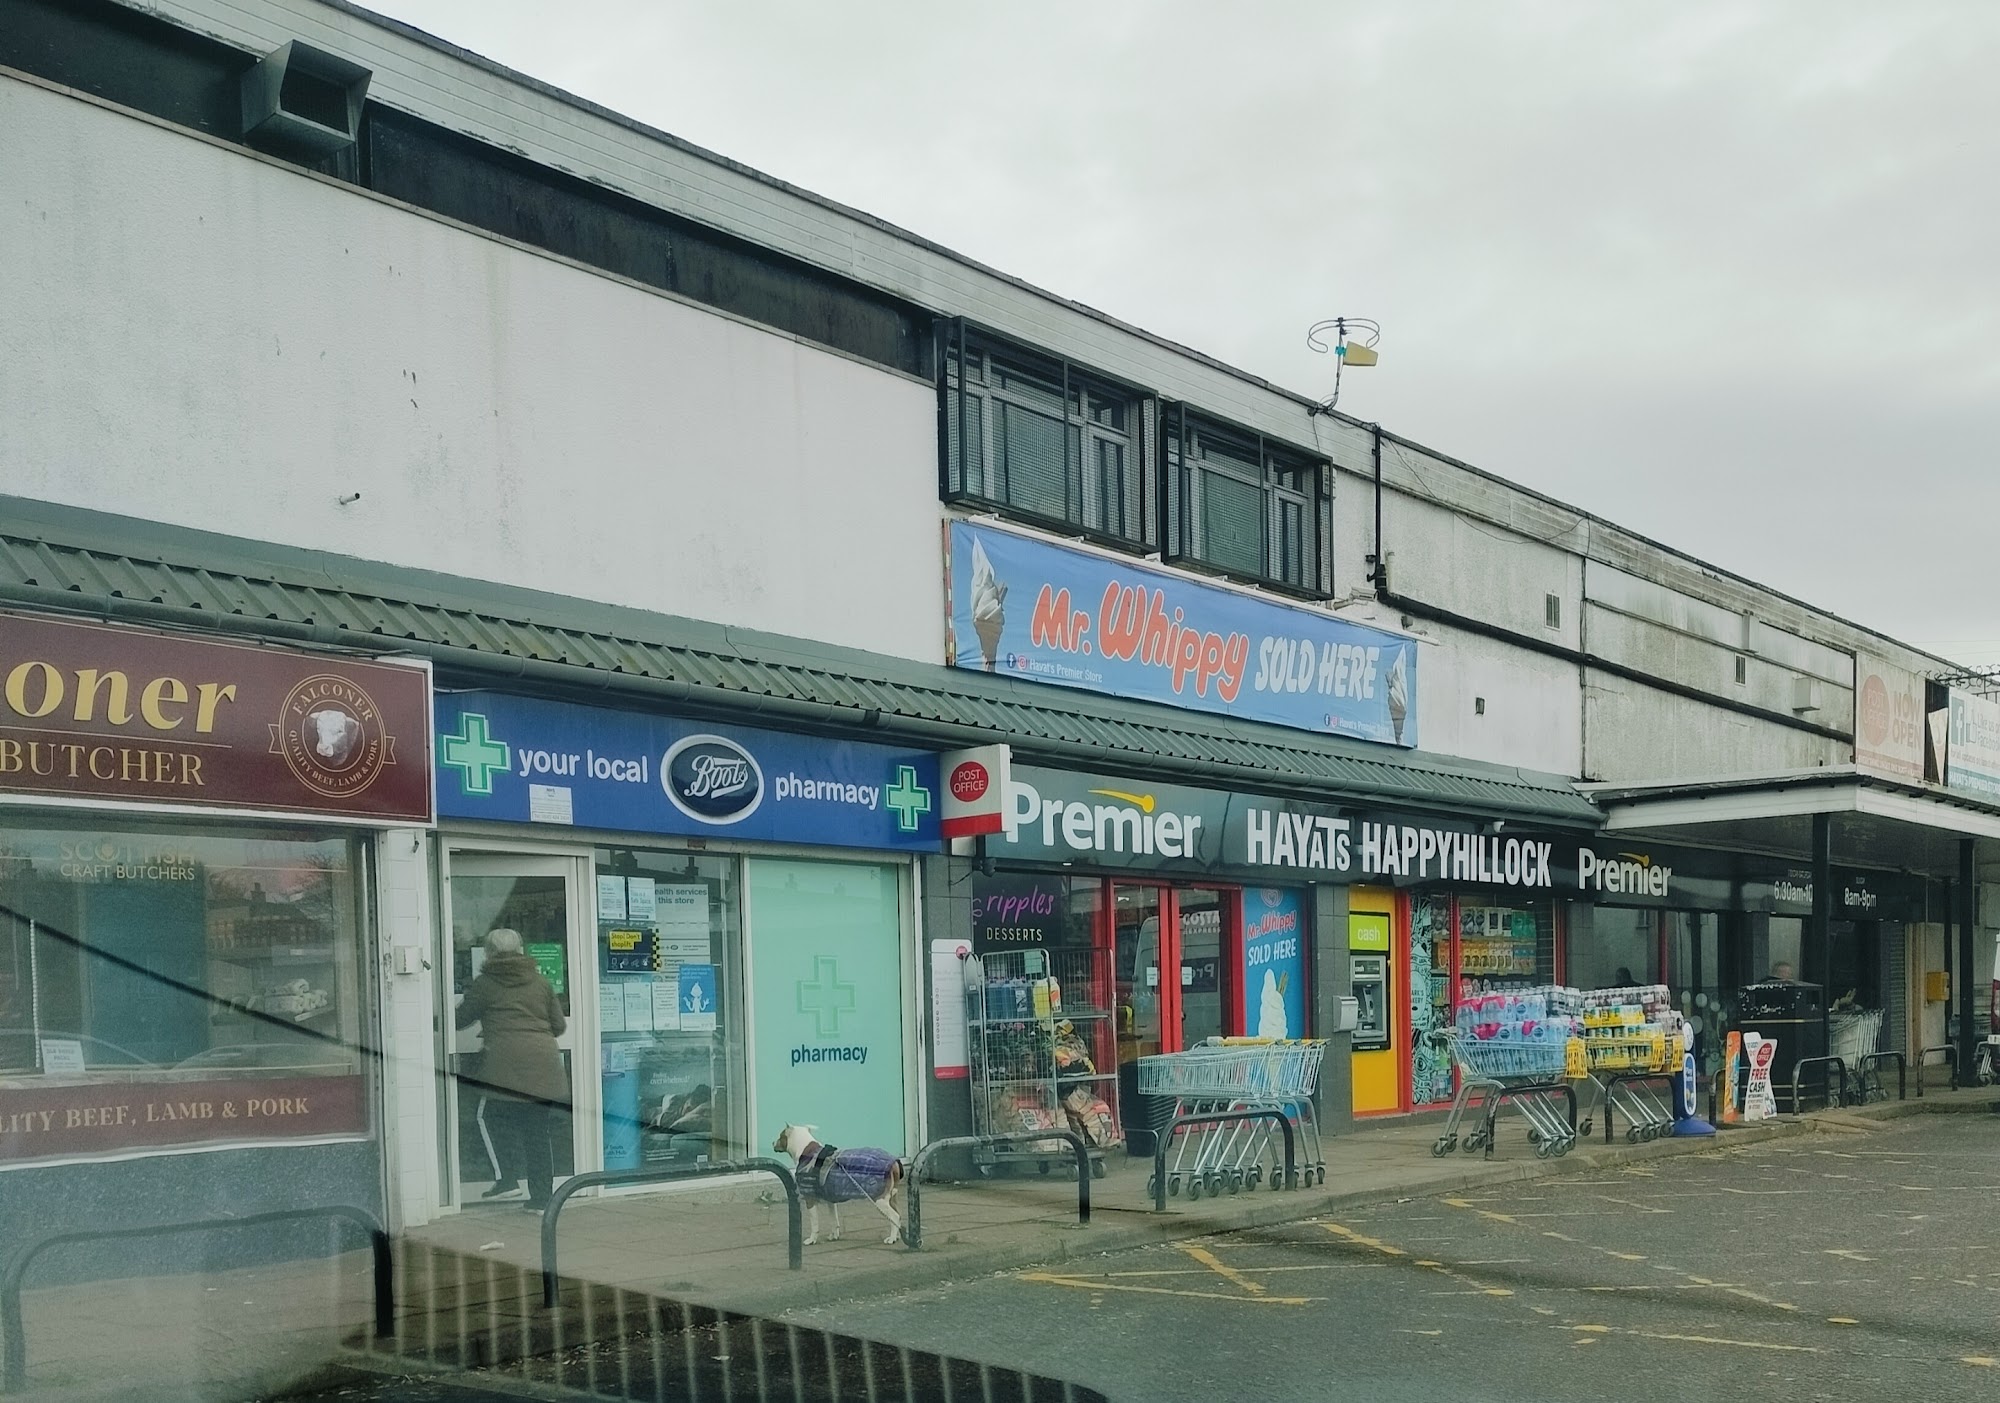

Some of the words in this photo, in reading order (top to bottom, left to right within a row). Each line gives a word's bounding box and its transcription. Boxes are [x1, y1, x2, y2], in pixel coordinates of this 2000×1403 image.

[1031, 583, 1092, 655] Mr.
[1099, 580, 1250, 703] Whippy
[1057, 664, 1083, 679] Premier
[1085, 669, 1103, 683] Store
[1255, 636, 1315, 694] SOLD
[1318, 641, 1381, 702] HERE
[5, 661, 237, 733] oner
[292, 683, 373, 721] FALCONER
[1894, 690, 1921, 723] NOW
[1892, 717, 1921, 750] OPEN
[0, 739, 205, 786] BUTCHER
[289, 730, 313, 772] QUALITY
[312, 770, 336, 787] BEEF,
[338, 772, 363, 787] LAMB
[362, 766, 369, 775] &
[366, 739, 378, 767] PORK
[518, 748, 580, 778] your
[587, 749, 649, 784] local
[958, 769, 981, 781] POST
[683, 754, 749, 799] Boots
[775, 772, 880, 811] pharmacy
[953, 780, 984, 793] OFFICE
[1006, 780, 1201, 858] Premier
[60, 841, 196, 865] SCOTTISH
[1362, 821, 1552, 888] HAPPYHILLOCK
[60, 863, 111, 878] CRAFT
[116, 865, 195, 881] BUTCHERS
[1579, 847, 1673, 897] Premier
[658, 897, 673, 905] this
[675, 897, 695, 905] store
[676, 888, 708, 896] services
[987, 884, 1055, 924] ripples
[986, 927, 1043, 942] DESSERTS
[1183, 911, 1221, 926] COSTA
[1247, 921, 1261, 941] Mr.
[1260, 909, 1297, 936] Whippy
[1357, 926, 1381, 941] cash
[1248, 943, 1271, 967] SOLD
[1273, 937, 1297, 961] HERE
[791, 1043, 868, 1067] pharmacy
[1749, 1081, 1766, 1093] CASH
[1751, 1068, 1769, 1081] FREE
[0, 1110, 56, 1133] LITY
[66, 1106, 137, 1128] BEEF,
[147, 1100, 214, 1122] LAMB
[222, 1101, 238, 1118] &
[247, 1097, 310, 1118] PORK
